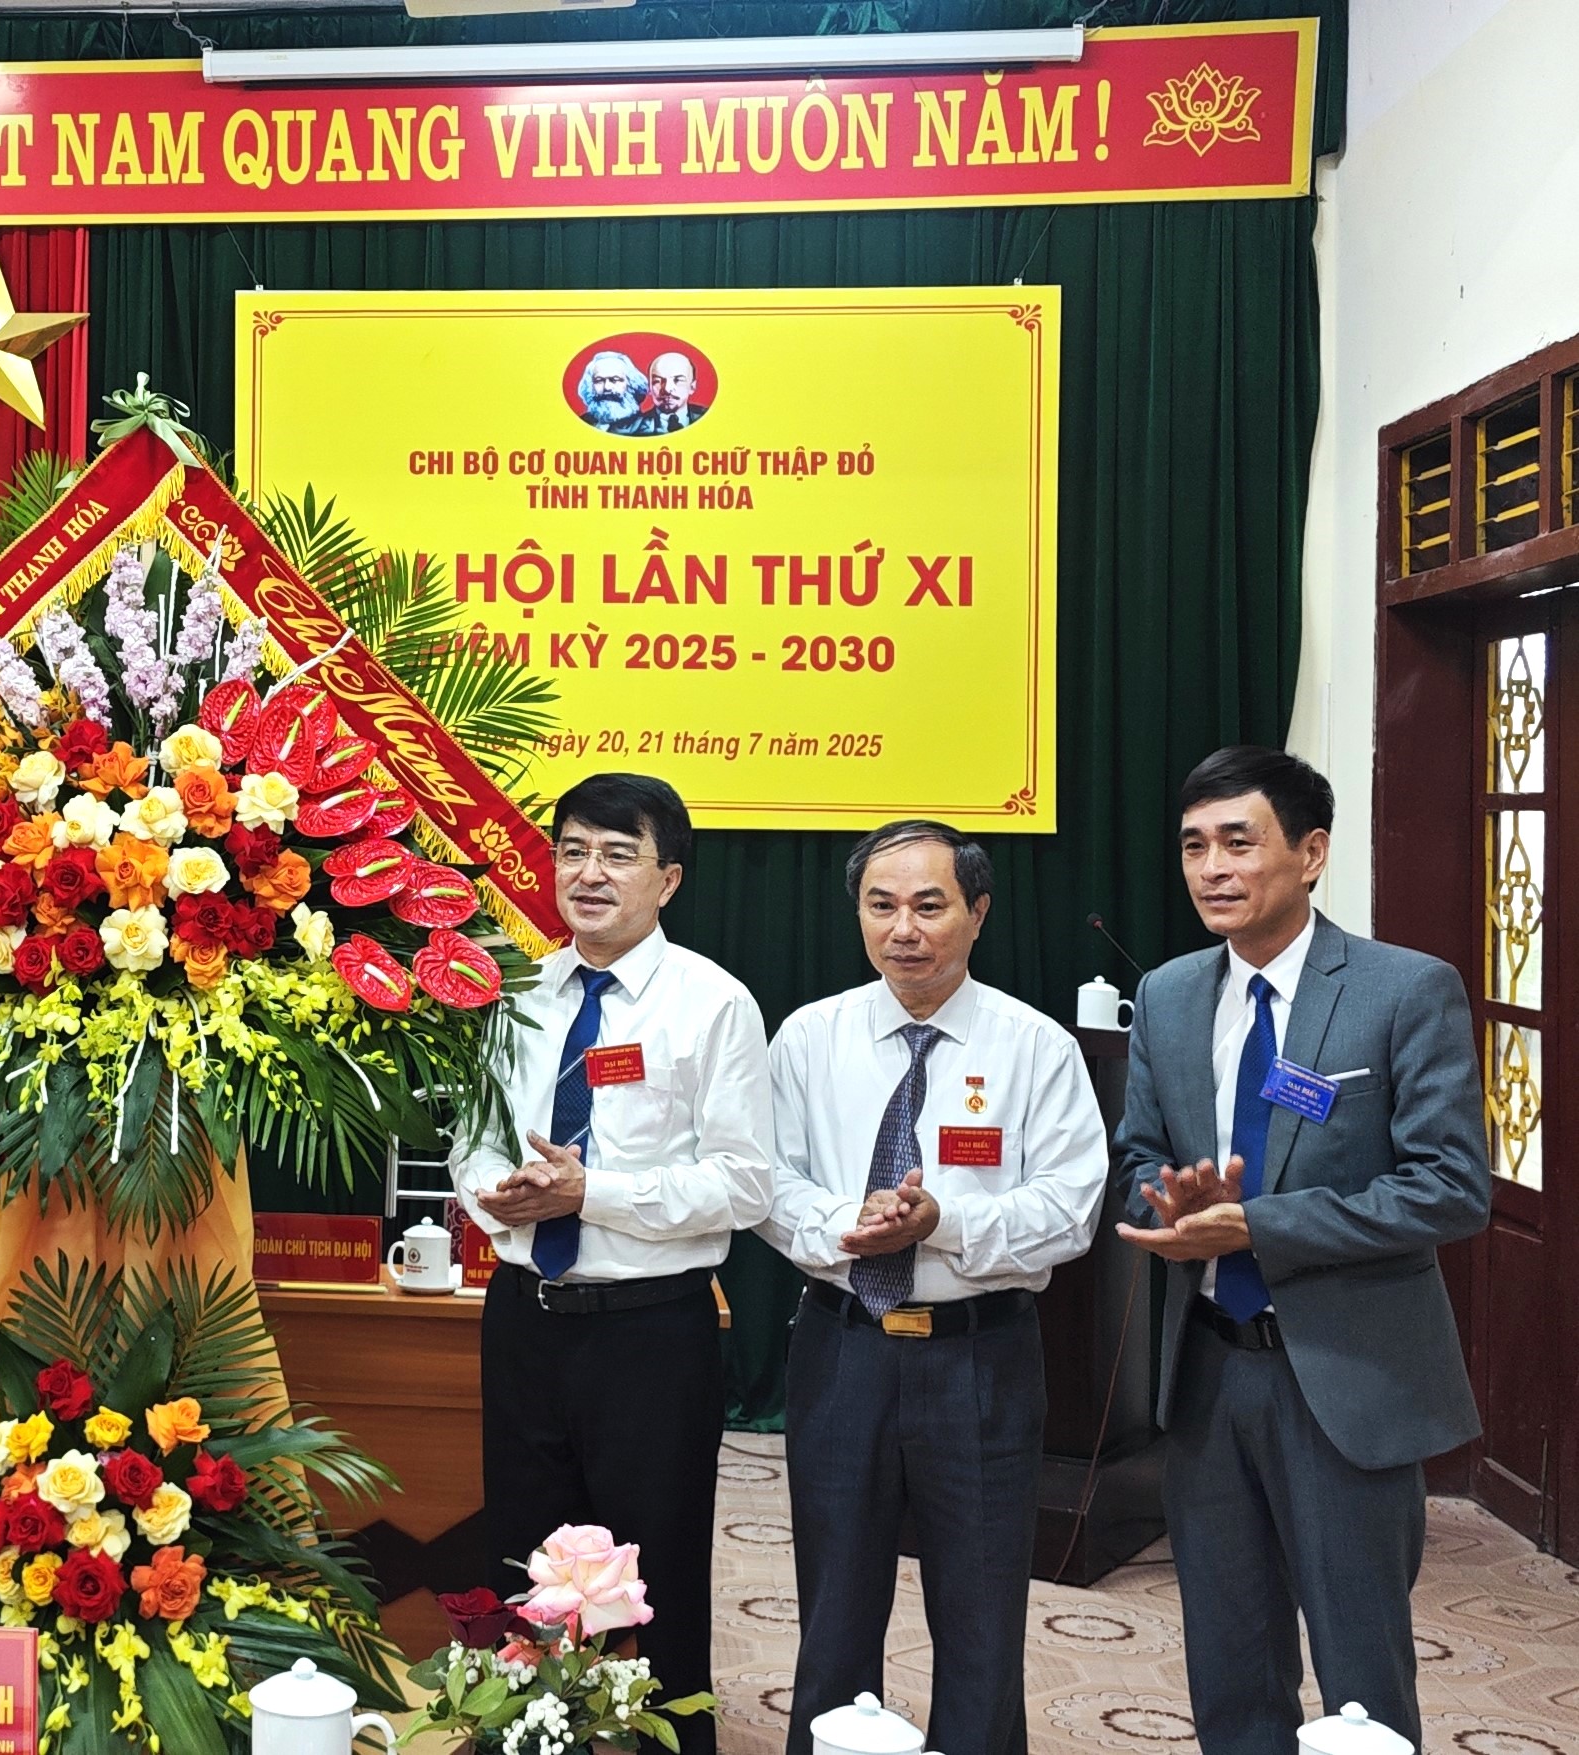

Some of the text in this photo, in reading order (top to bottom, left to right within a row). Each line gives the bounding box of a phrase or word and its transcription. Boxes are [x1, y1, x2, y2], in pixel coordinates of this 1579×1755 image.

[51, 111, 204, 187] NAM
[220, 105, 465, 190] QUANG
[483, 98, 662, 179] VINH
[681, 71, 893, 177] MUÔN
[409, 442, 875, 481] CHI BỘ CƠ QUAN HỘI CHỮ THẬP ĐỎ
[527, 480, 754, 510] TỈNH THANH HÓA
[0, 535, 67, 602] THANH
[62, 497, 110, 544] HÓA
[455, 538, 575, 619] HỘI
[603, 527, 727, 606] LẦN
[752, 528, 886, 608] THỨ
[905, 556, 973, 607] XI
[550, 622, 609, 670] KỲ
[625, 633, 737, 671] 2025
[752, 652, 766, 661] -
[781, 635, 896, 673] 2030
[254, 553, 366, 698] Chúc
[364, 660, 478, 826] Mừng
[533, 728, 591, 759] ngày
[591, 732, 631, 757] 20,
[638, 732, 665, 754] 21
[673, 729, 742, 760] tháng
[749, 733, 763, 755] 7
[768, 731, 822, 757] năm
[827, 734, 884, 758] 2025
[255, 1233, 372, 1261] ĐOÀN CHỦ TỊCH ĐẠI HỘI
